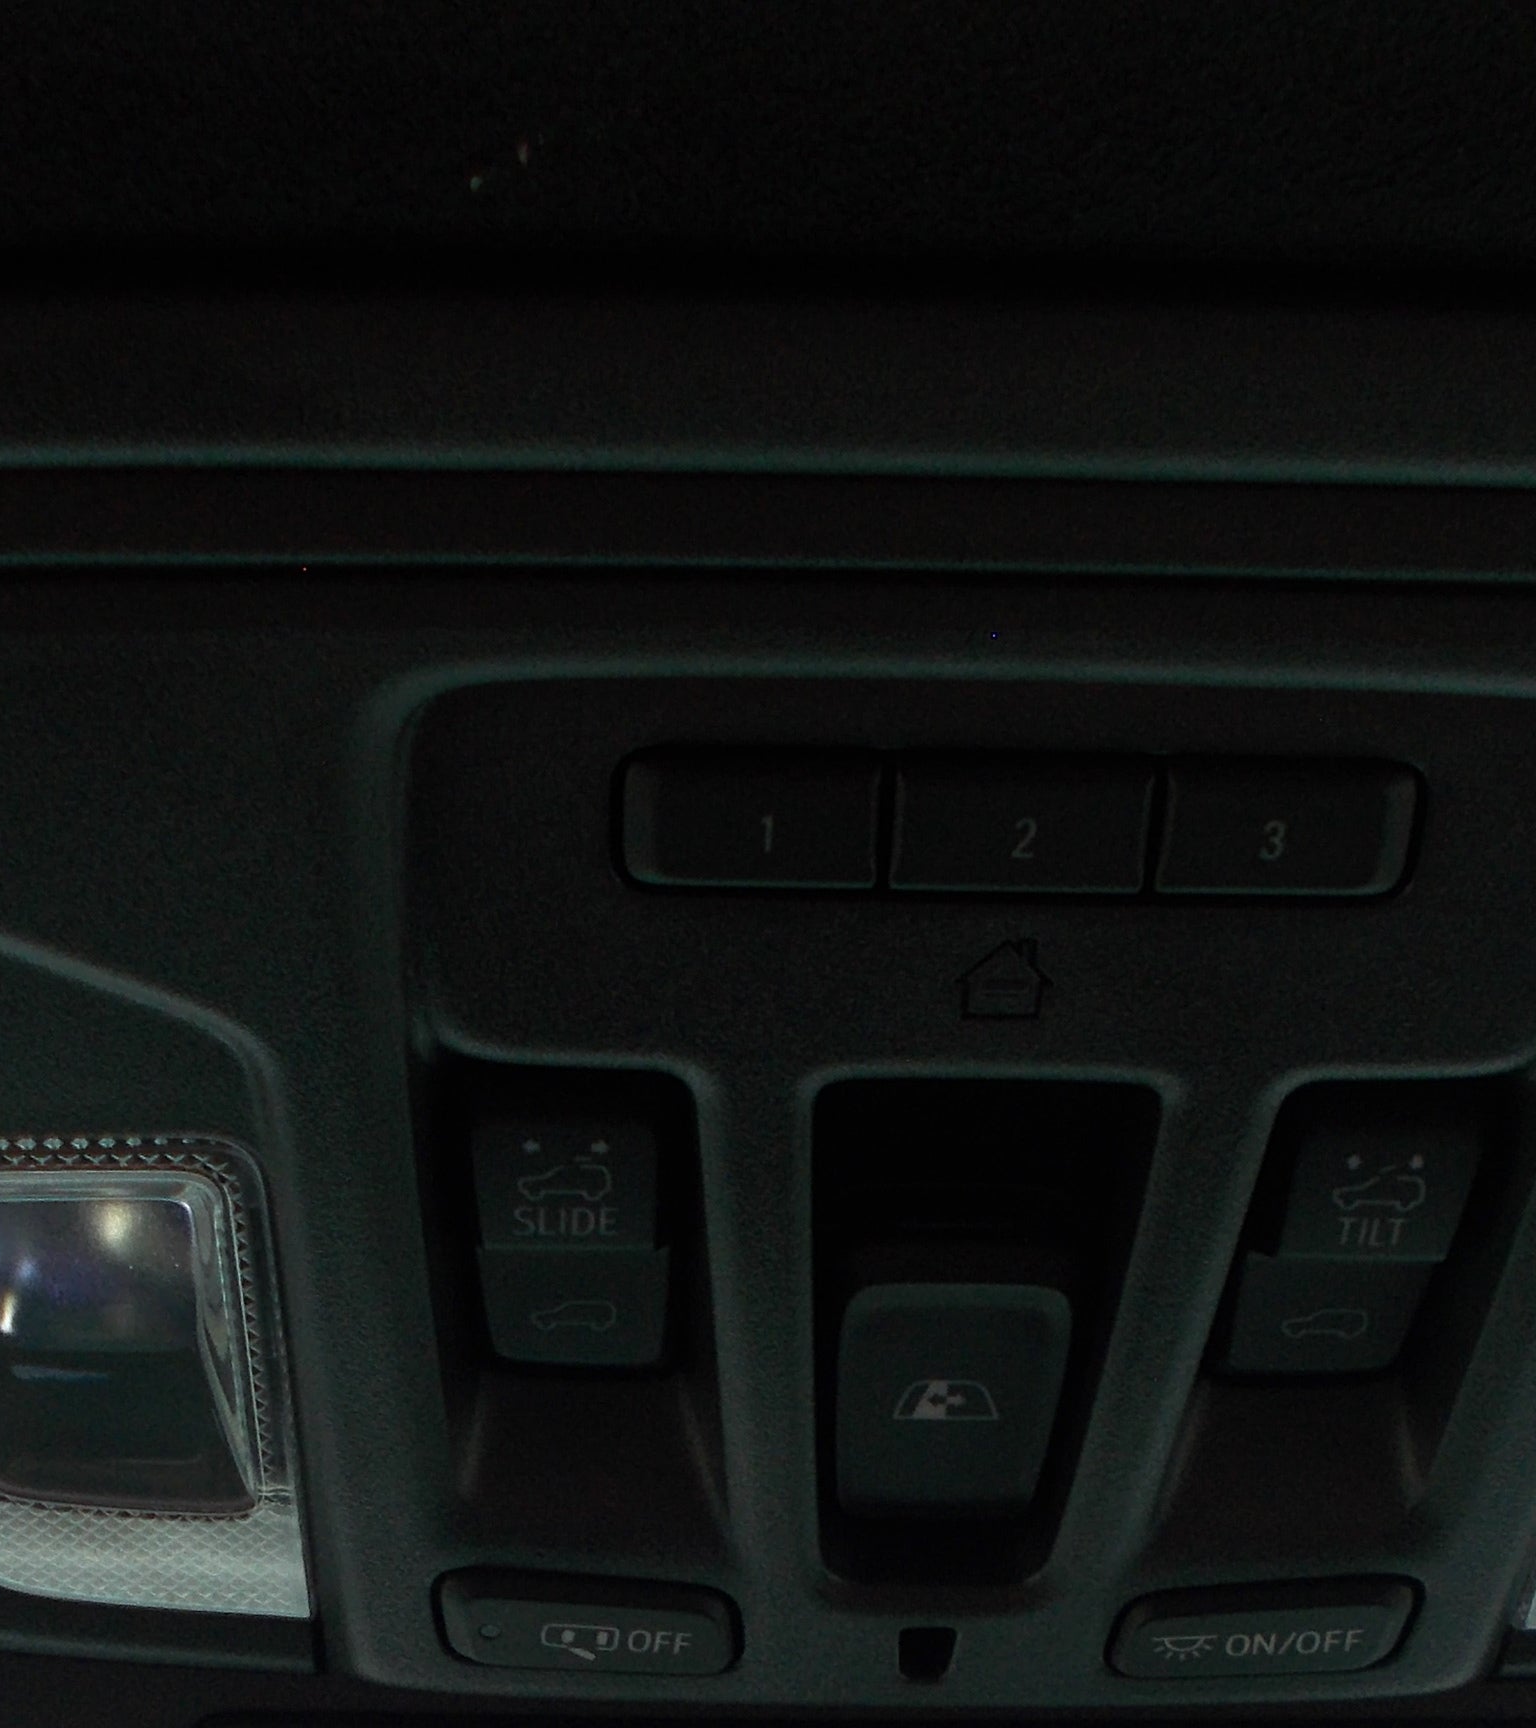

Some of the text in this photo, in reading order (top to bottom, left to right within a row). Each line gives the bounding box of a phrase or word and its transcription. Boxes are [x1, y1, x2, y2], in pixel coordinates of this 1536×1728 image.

[759, 814, 775, 854] 1
[1010, 816, 1039, 860] 2
[1258, 819, 1289, 861] 3
[512, 1206, 620, 1237] SLIDE
[1335, 1217, 1408, 1248] TILT
[626, 1629, 693, 1655] OFF
[1224, 1629, 1366, 1657] ON/OFF
